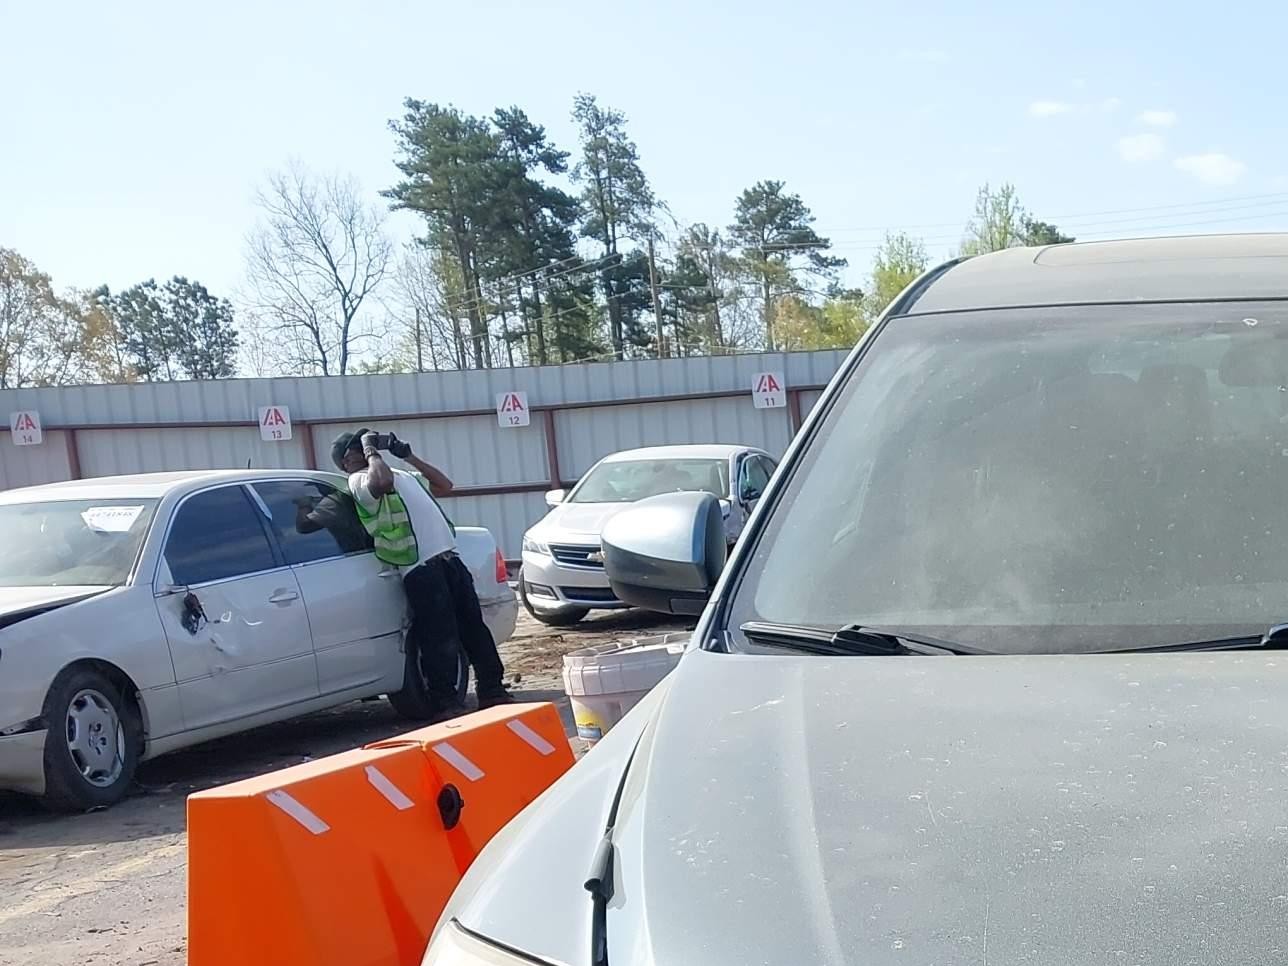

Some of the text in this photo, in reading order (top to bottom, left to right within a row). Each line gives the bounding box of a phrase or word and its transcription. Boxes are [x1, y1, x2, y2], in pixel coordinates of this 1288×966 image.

[764, 397, 775, 406] 11
[509, 415, 520, 425] 12
[23, 435, 33, 443] 14
[271, 430, 282, 439] 13
